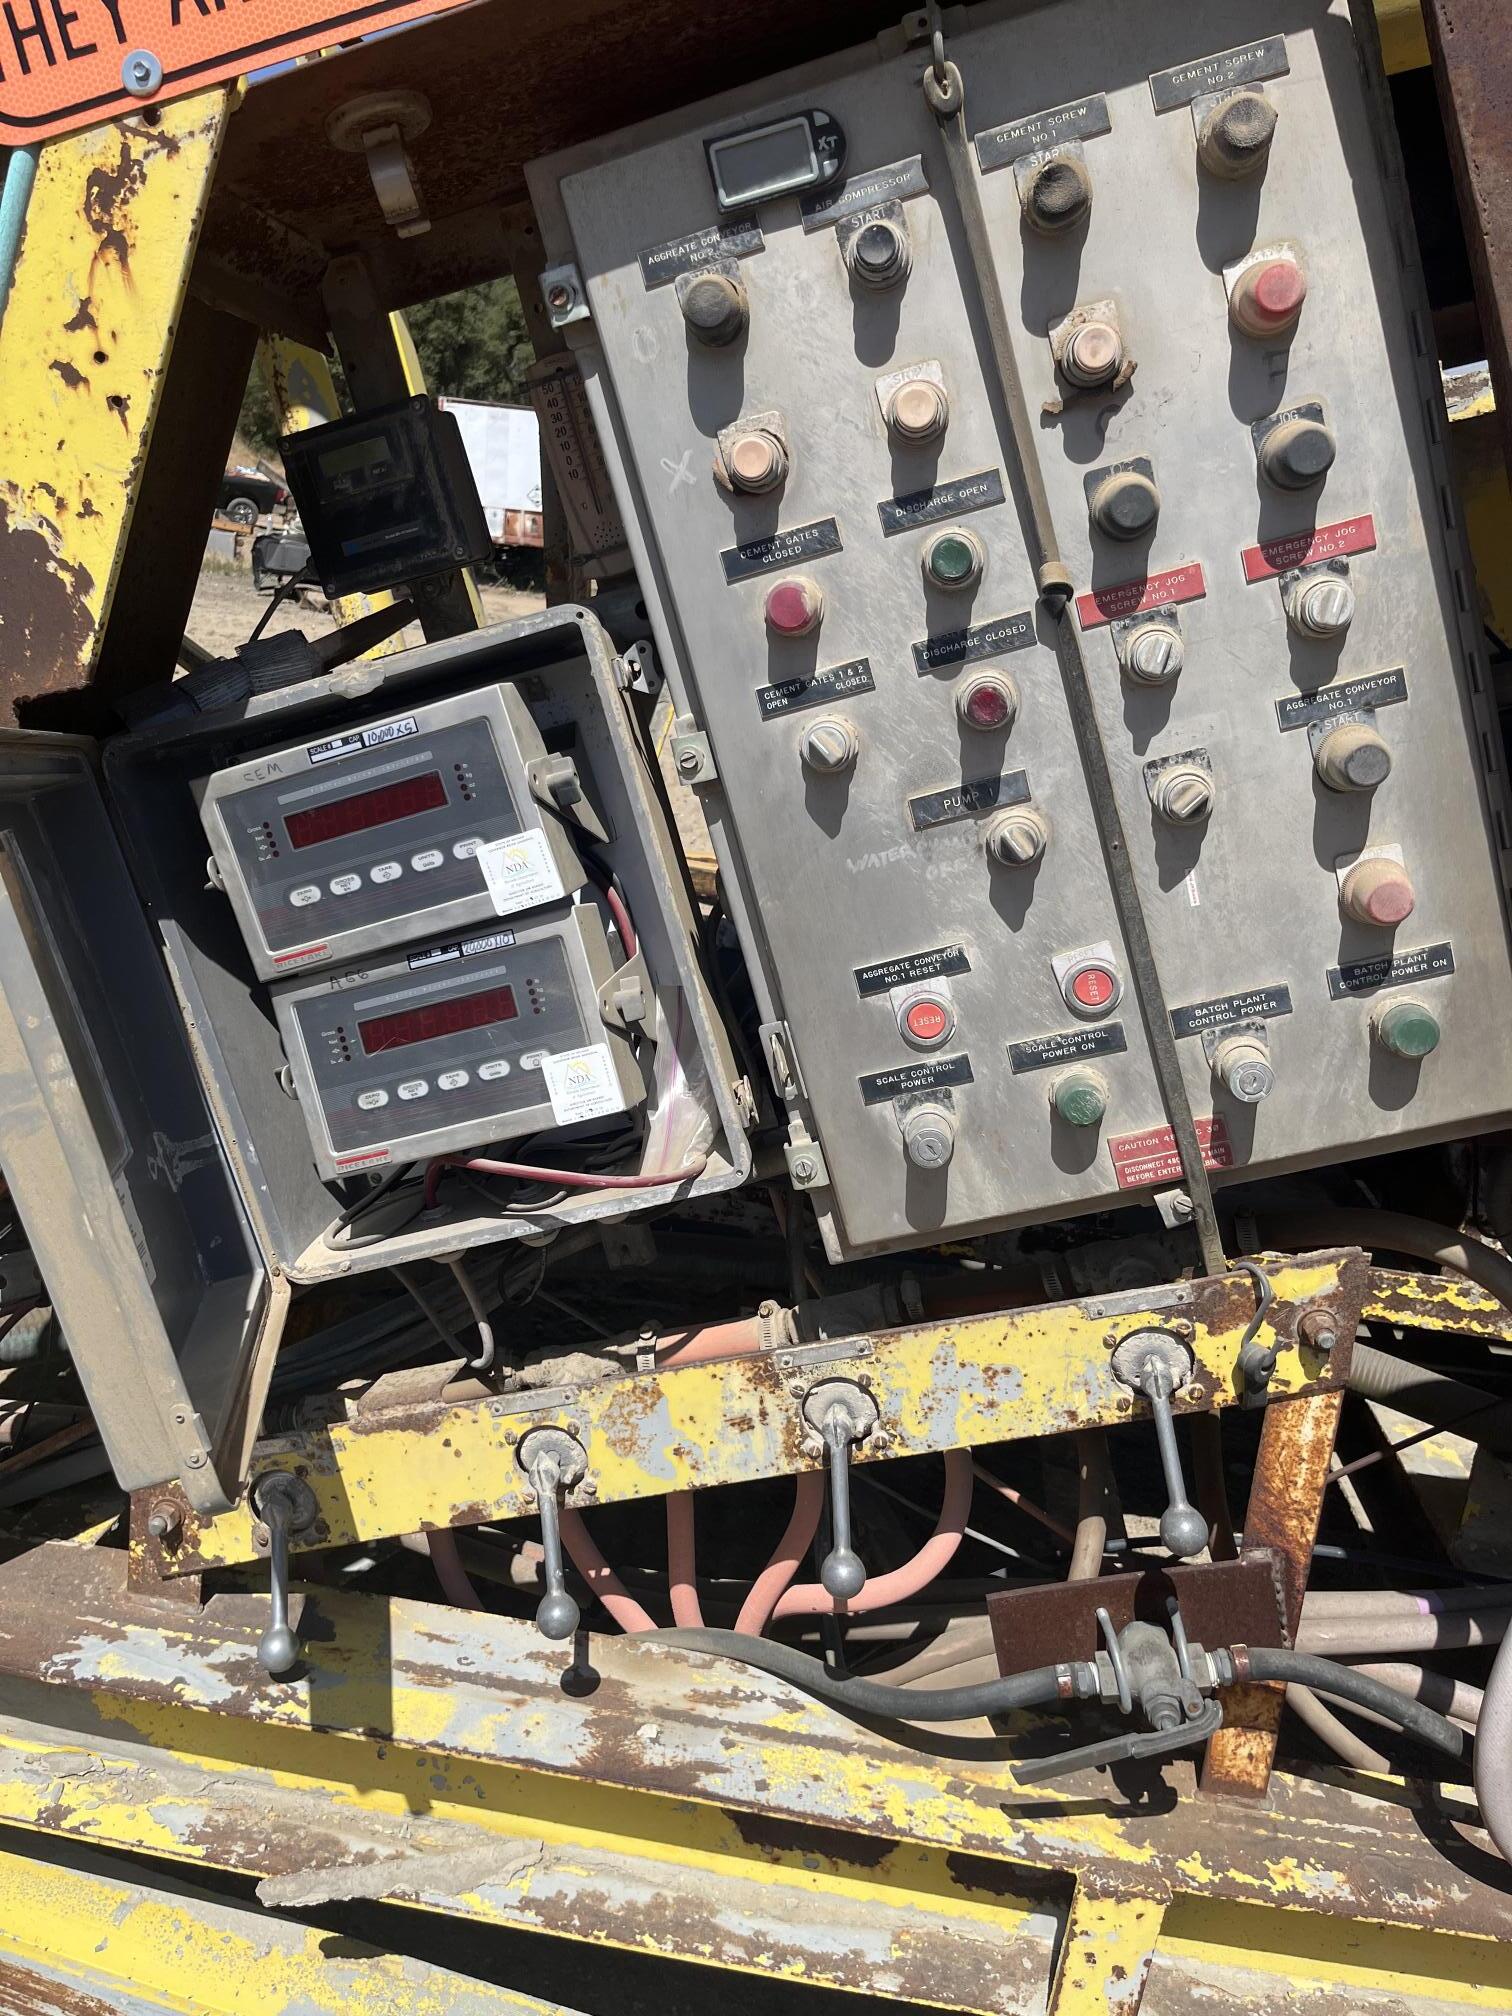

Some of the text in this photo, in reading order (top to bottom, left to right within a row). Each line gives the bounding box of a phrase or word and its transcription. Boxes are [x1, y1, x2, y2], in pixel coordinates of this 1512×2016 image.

[0, 0, 128, 83] HEY
[1172, 49, 1265, 85] CEMENT SCREW
[996, 107, 1087, 144] CEMENT SCREW
[818, 135, 839, 151] XT
[814, 173, 912, 212] AIR COMPRESSOR
[851, 207, 887, 229] START
[648, 222, 752, 266] AGGREATE CONVEYOR
[550, 412, 563, 424] 30
[555, 426, 567, 438] 20
[560, 440, 571, 451] 10
[565, 455, 573, 466] 0
[567, 468, 579, 480] 10
[895, 484, 988, 517] DISCHARGE OPEN
[740, 529, 819, 560] CEMENT GATES
[1263, 526, 1356, 558] EMERGENCY JOG
[1275, 541, 1345, 565] SCREW NO.2
[762, 545, 802, 563] CLOSED
[1095, 574, 1185, 605] EMERGENCY JOG
[1110, 597, 1147, 612] SCREW
[1152, 588, 1176, 600] NO.1
[923, 624, 1026, 660] DISCHARGE CLOSED
[764, 682, 801, 700] CEMENT
[805, 674, 835, 688] GATES
[847, 668, 854, 676] &
[858, 665, 864, 673] 2
[766, 675, 868, 710] OPEN CLOSED
[1286, 675, 1397, 711] AGGREGATE CONVEYOR
[1328, 698, 1353, 710] NO.1
[1324, 711, 1361, 730] START
[309, 744, 328, 754] SCALE
[943, 792, 980, 809] PUMP
[505, 861, 529, 875] NDA
[847, 844, 917, 875] WATER
[862, 949, 960, 980] AGGREGATE CONVEYOR
[884, 963, 942, 984] NO.1 RESET
[1339, 959, 1448, 989] CONTROL POWER ON
[1354, 953, 1429, 976] BATCH PLANT
[1087, 973, 1100, 1001] RESET
[1188, 1001, 1277, 1028] CONTROL POWER
[1195, 993, 1267, 1017] BATCH PLANT
[914, 1015, 942, 1027] RESET
[1025, 1030, 1109, 1054] SCALE CONTROL
[1042, 1042, 1096, 1060] POWER ON
[568, 1073, 591, 1087] NDA
[876, 1063, 956, 1086] SCALE CONTROL
[900, 1076, 935, 1089] POWER
[1118, 1137, 1159, 1152] CAUTION
[1124, 1161, 1165, 1174] DISCONNECT
[1126, 1172, 1155, 1184] BEFORE
[1157, 1165, 1183, 1177] ENTER
